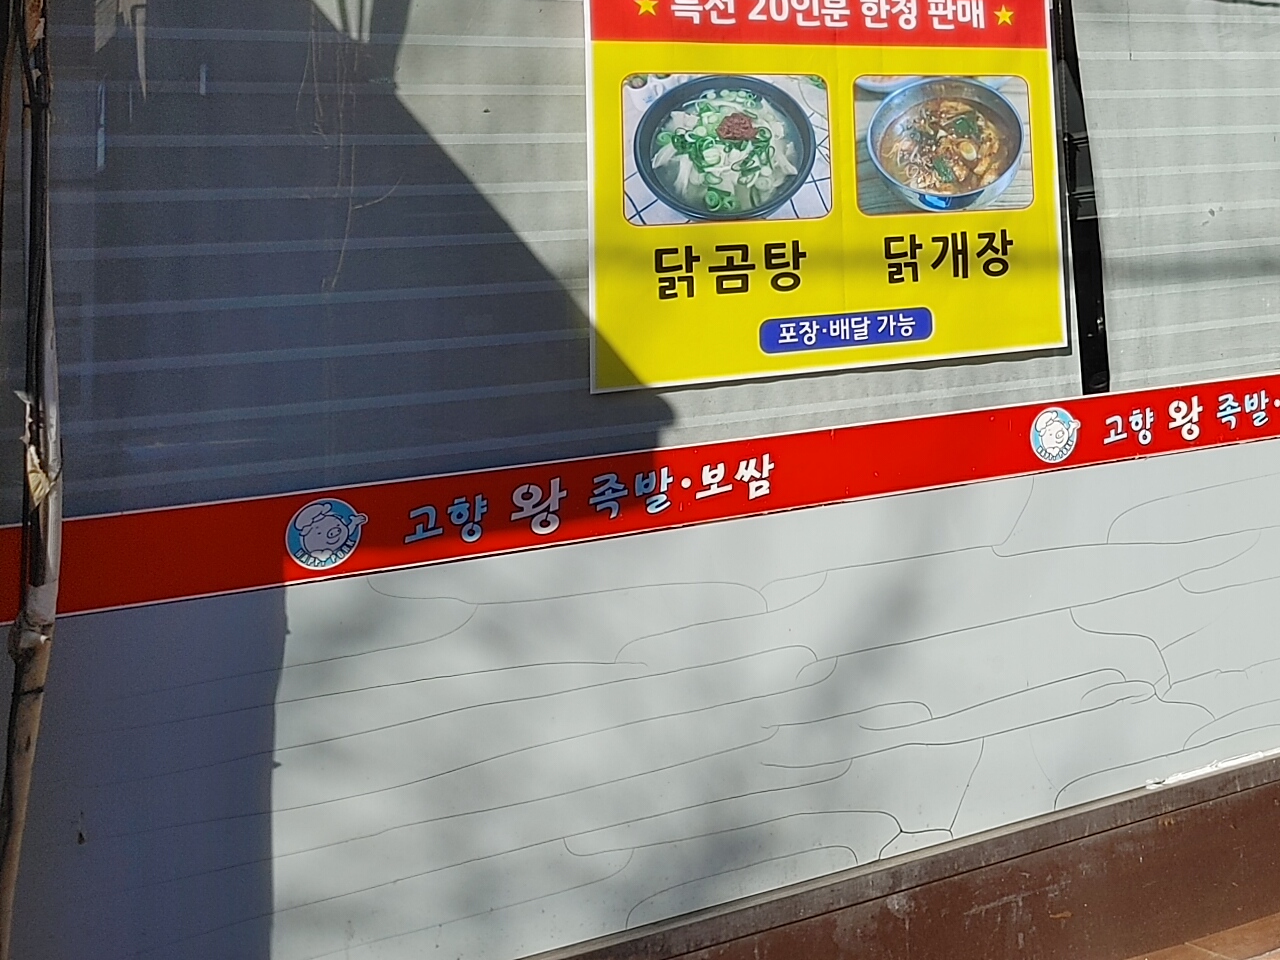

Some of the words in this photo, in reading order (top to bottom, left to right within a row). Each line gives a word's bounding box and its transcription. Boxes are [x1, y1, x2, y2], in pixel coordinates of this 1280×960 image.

[653, 240, 807, 300] 닭곰탕
[884, 229, 1013, 283] 닭개장
[877, 315, 916, 337] 가능
[1103, 408, 1155, 445] 고향
[1168, 395, 1204, 441] 왕
[404, 494, 489, 544] 고향
[510, 477, 568, 535] 왕
